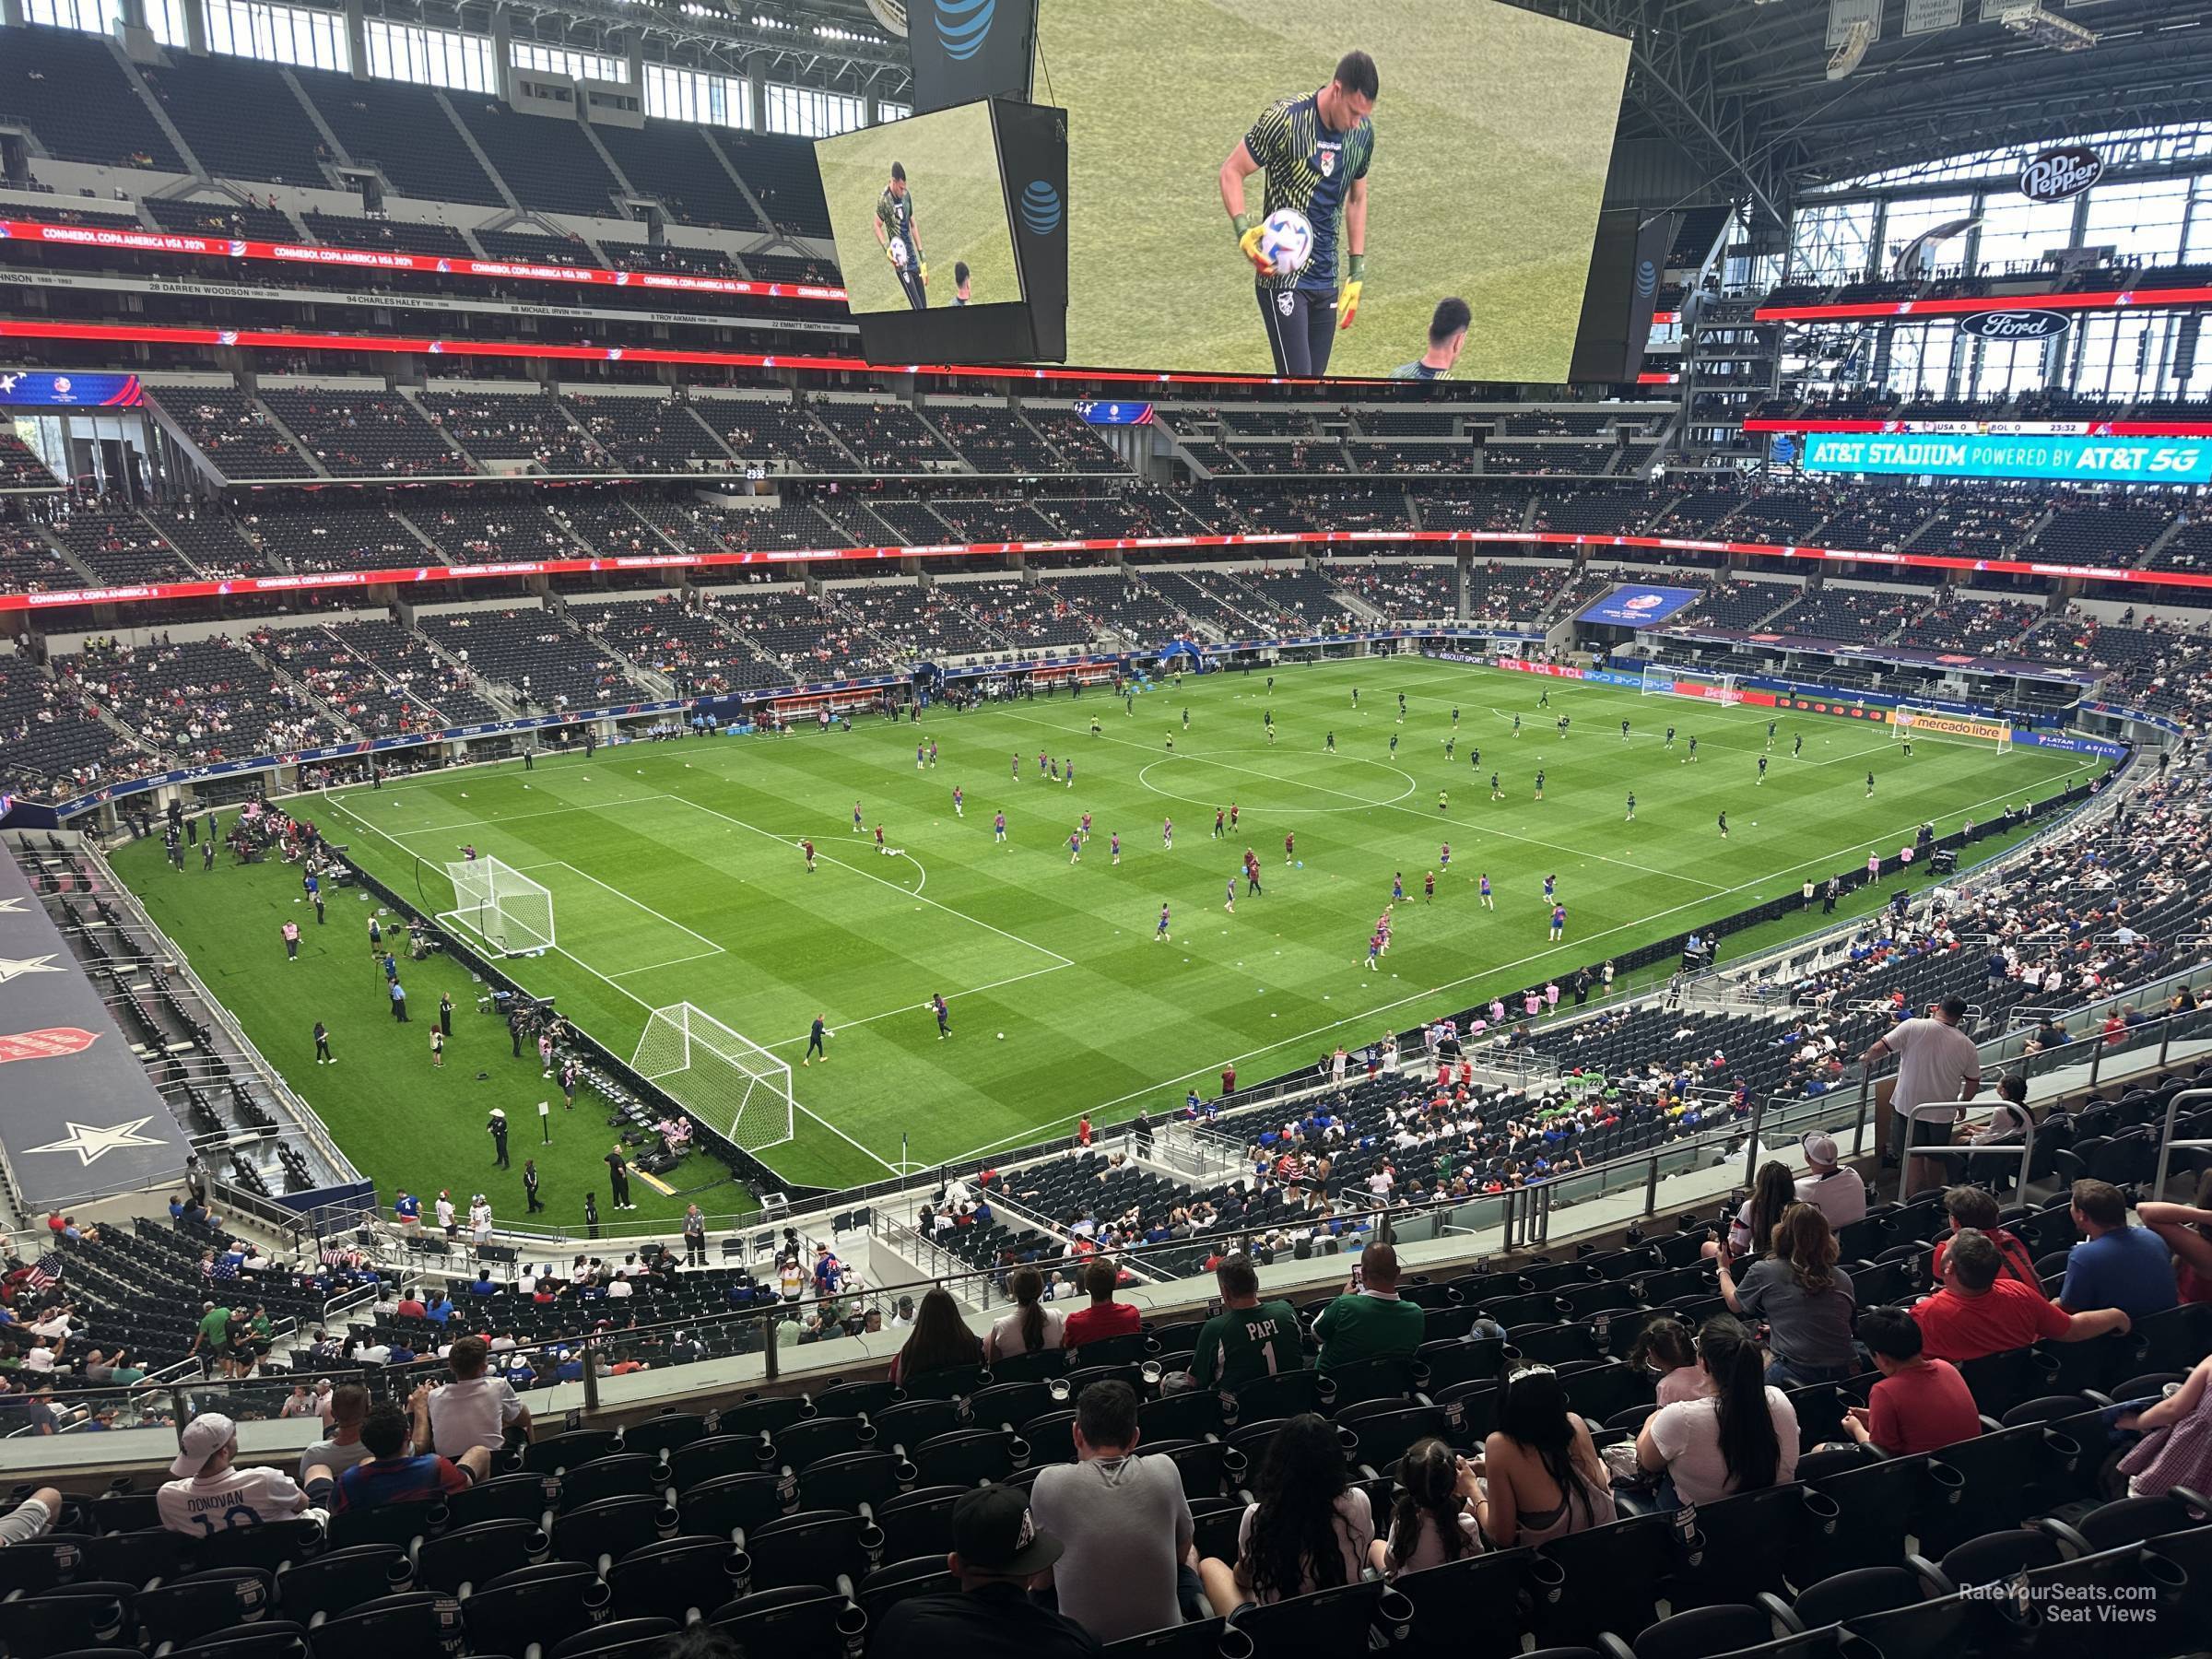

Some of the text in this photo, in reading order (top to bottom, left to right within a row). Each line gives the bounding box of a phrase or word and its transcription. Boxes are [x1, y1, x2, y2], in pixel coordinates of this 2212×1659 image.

[2051, 156, 2080, 177] Dr
[2030, 161, 2099, 197] Pepper
[43, 228, 206, 250] CONMEBOL COPA AMERICA USA 2024
[274, 247, 319, 259] CONMEBOL
[320, 251, 342, 261] COPA
[471, 263, 511, 275] CONMEBOL
[512, 266, 530, 275] COPA
[163, 284, 201, 294] DARREN
[204, 287, 250, 296] WOODSON
[358, 297, 395, 306] CHARLES
[396, 299, 421, 307] HALEY
[521, 306, 550, 315] MICHAEL
[1982, 314, 2048, 335] Ford
[1813, 442, 2201, 472] AT&T STADIUM POWERED BY AT&T 5G
[256, 578, 300, 588] CONMEBOL
[301, 577, 323, 585] COPA
[29, 588, 149, 604] CONMEBOL COPA AMERICA
[1439, 652, 1465, 662] ABSOLUT
[1465, 655, 1484, 665] SPORT
[1499, 658, 1523, 671] TCL
[1529, 662, 1553, 675] TCL
[1558, 667, 1583, 679] TCL
[1584, 671, 1611, 681] BYD
[1613, 674, 1641, 686] BYD
[1643, 678, 1674, 690] BYD
[1918, 719, 1971, 735] mercado
[1972, 724, 2000, 738] libre
[2047, 737, 2074, 745] LATAM
[2093, 746, 2116, 754] DELTA
[405, 1201, 411, 1210] 4
[1246, 1318, 1280, 1341] PAPI
[1261, 1341, 1278, 1376] 1
[187, 1489, 244, 1513] DONOVAN
